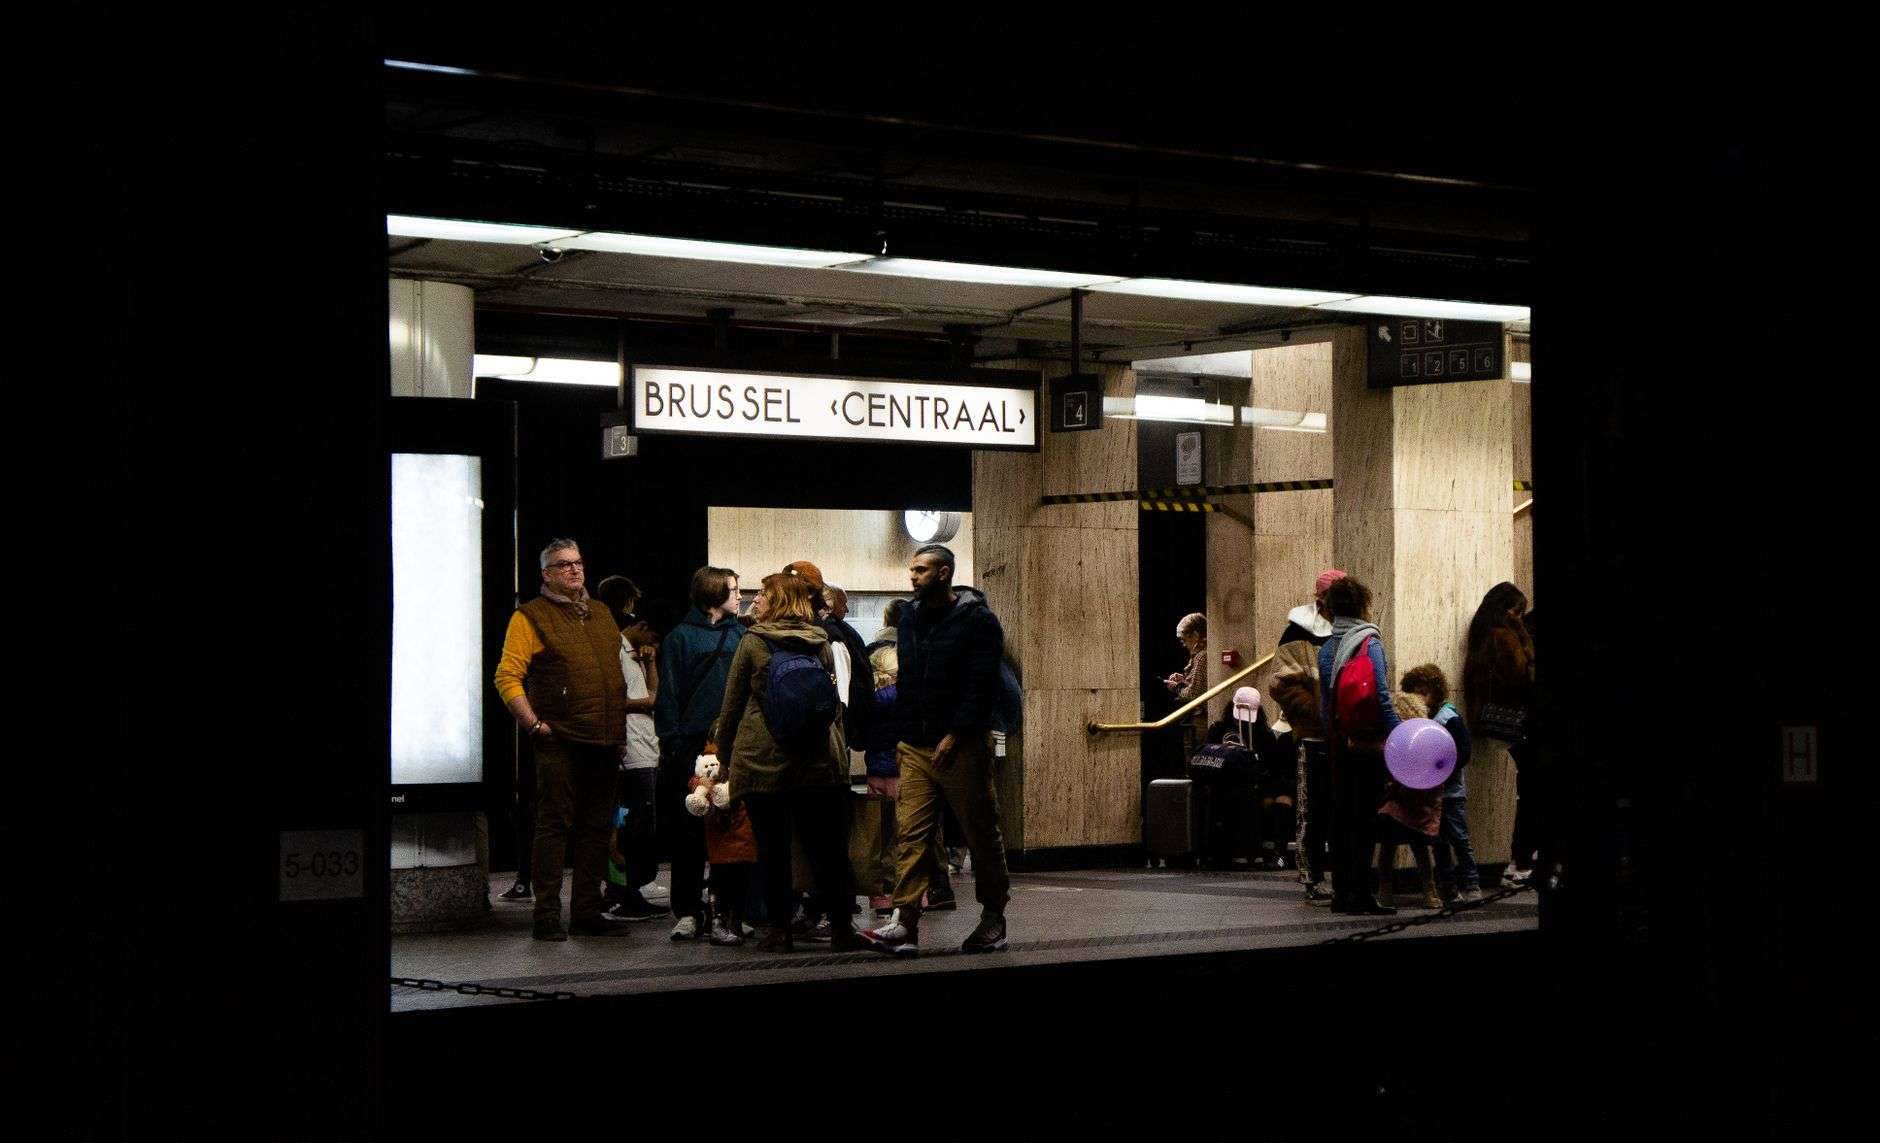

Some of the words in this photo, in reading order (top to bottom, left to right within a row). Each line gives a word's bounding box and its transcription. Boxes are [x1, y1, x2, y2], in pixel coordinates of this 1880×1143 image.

[1434, 359, 1441, 372] 2
[1484, 356, 1491, 369] 6
[645, 381, 801, 423] BRUSSEL
[1076, 404, 1083, 421] 4
[620, 435, 627, 451] 3
[1788, 731, 1811, 775] H
[285, 850, 359, 878] 5-033
